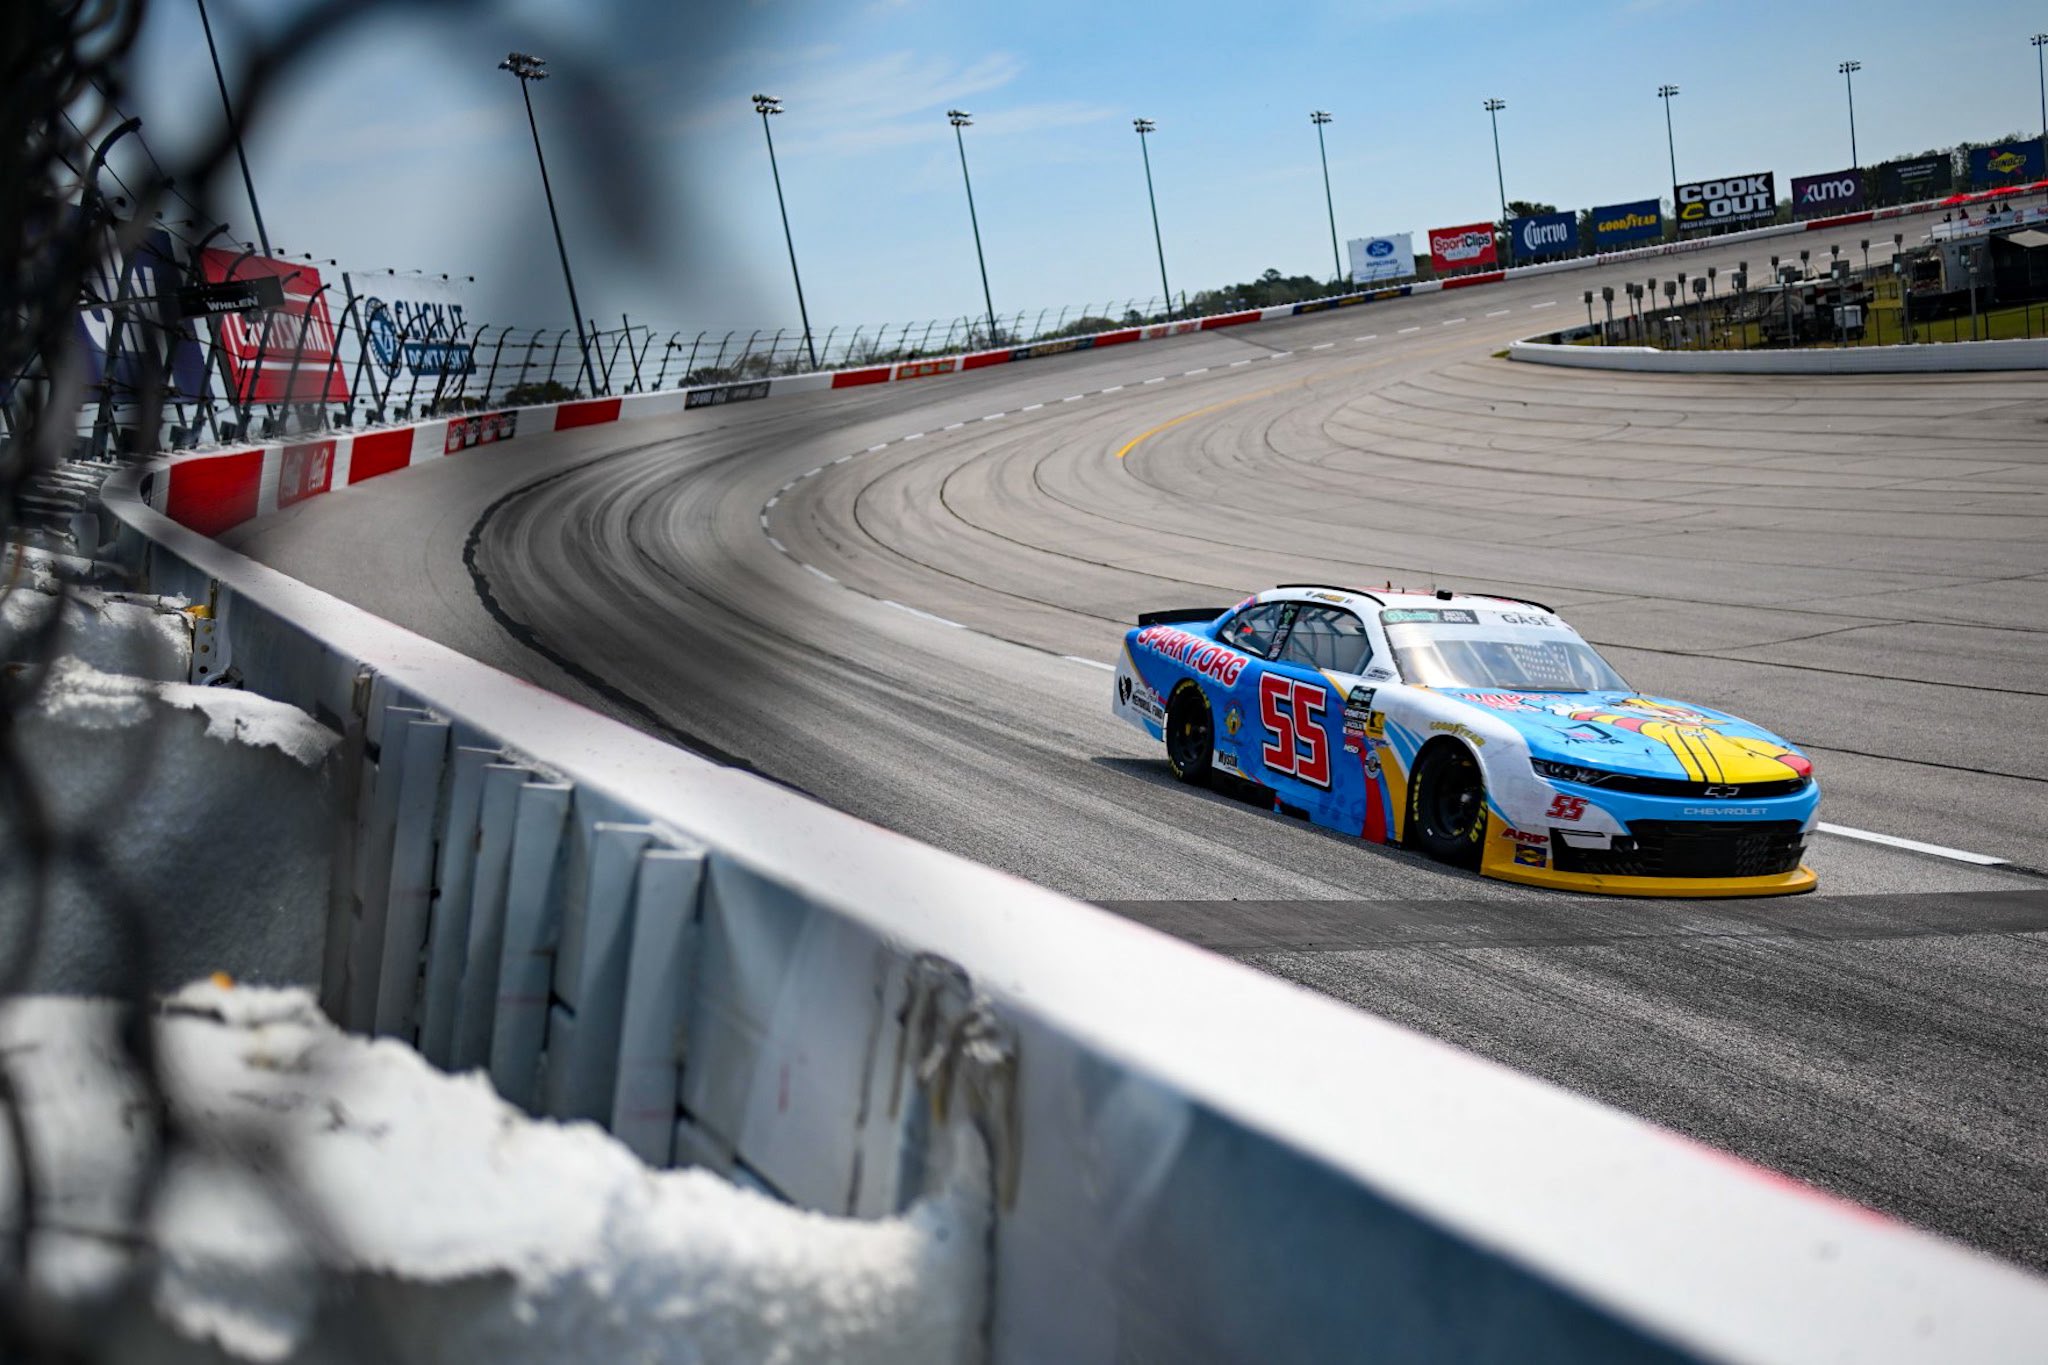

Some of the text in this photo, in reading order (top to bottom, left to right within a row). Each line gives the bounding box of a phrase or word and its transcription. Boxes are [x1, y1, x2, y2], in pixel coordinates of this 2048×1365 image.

[1989, 154, 2026, 171] SUNOCO
[1679, 176, 1768, 203] COOK
[1709, 192, 1770, 218] OUT
[1523, 220, 1568, 250] Cuervo
[1598, 213, 1657, 232] GOODYEAR
[206, 296, 259, 312] WHELEN
[395, 300, 450, 340] CLICK
[447, 303, 467, 340] IT
[1501, 613, 1556, 628] GASE
[1137, 625, 1250, 688] SPARKY.ORG
[1259, 671, 1331, 788] 55
[1429, 721, 1486, 747] GOODYEAR
[1545, 795, 1590, 822] 55
[1684, 806, 1768, 816] CHEVROLET
[1502, 827, 1549, 845] ARP
